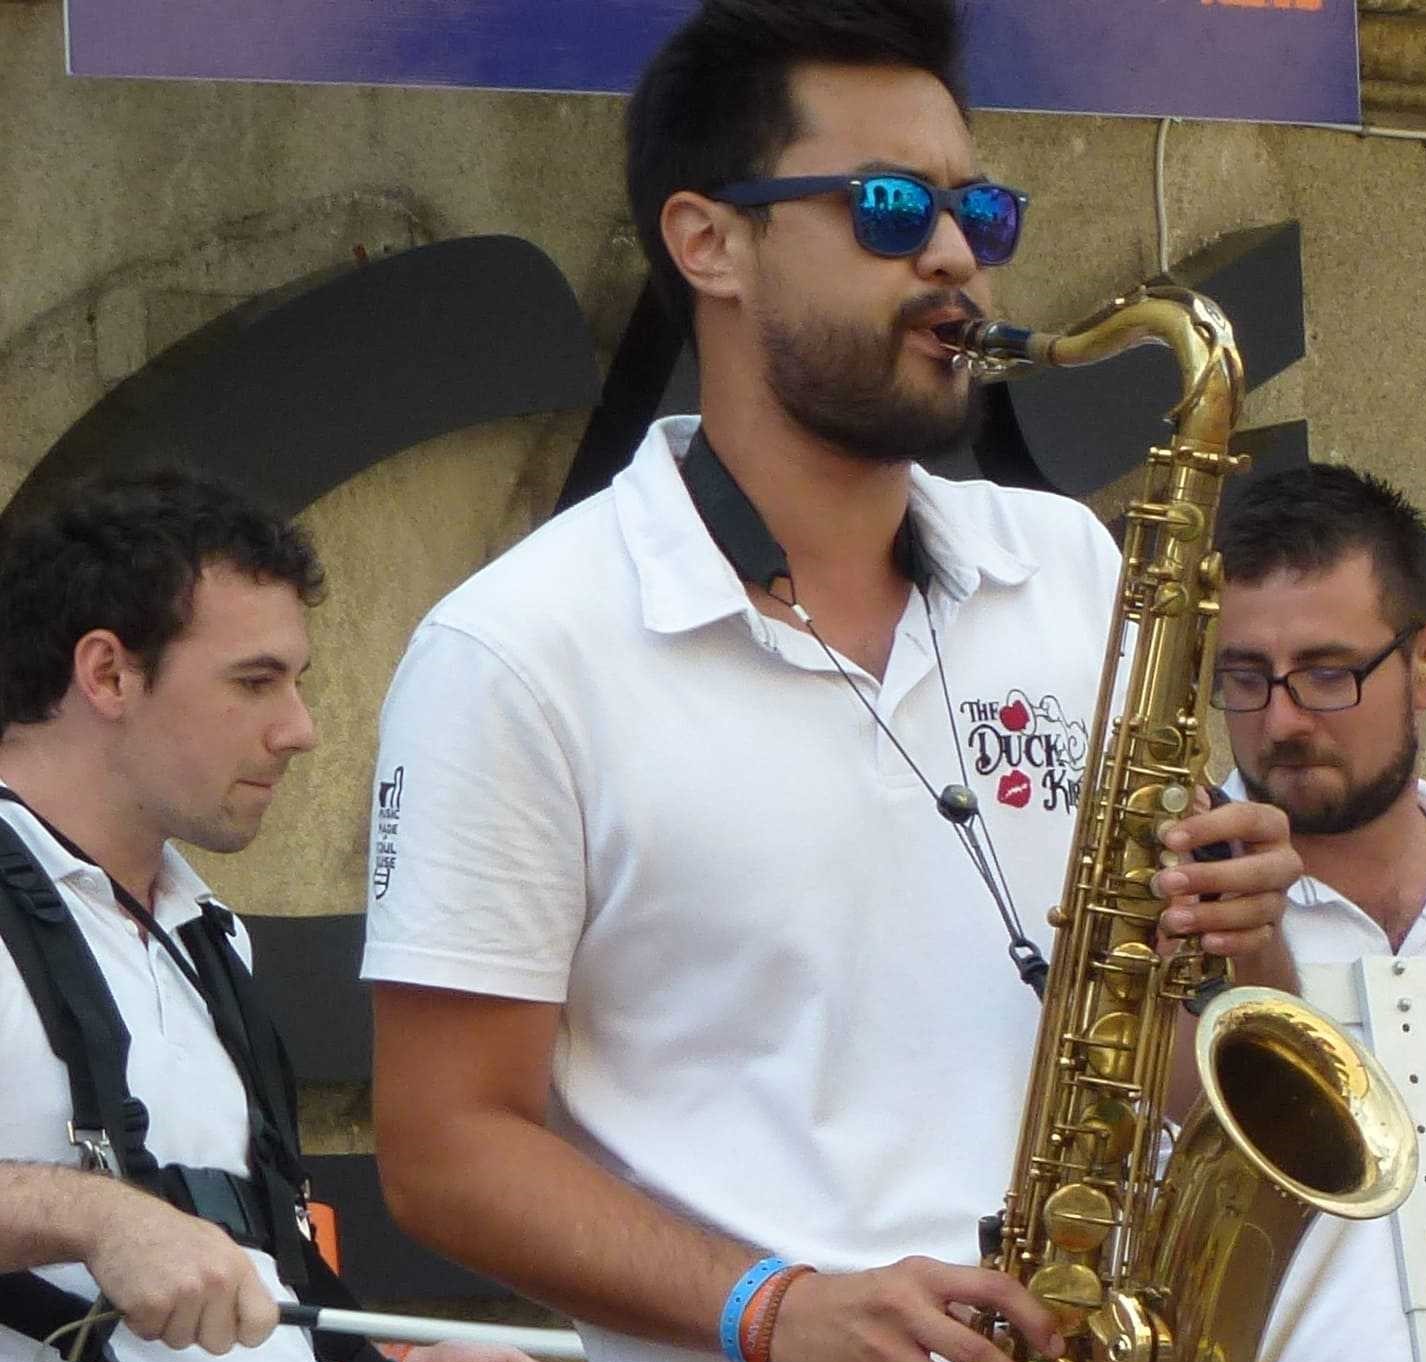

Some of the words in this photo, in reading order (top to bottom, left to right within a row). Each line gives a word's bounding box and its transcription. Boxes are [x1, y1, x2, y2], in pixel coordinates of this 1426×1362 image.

[960, 699, 999, 723] THE
[968, 723, 1062, 776] DUCK
[376, 841, 397, 855] OUL
[376, 856, 397, 869] USE
